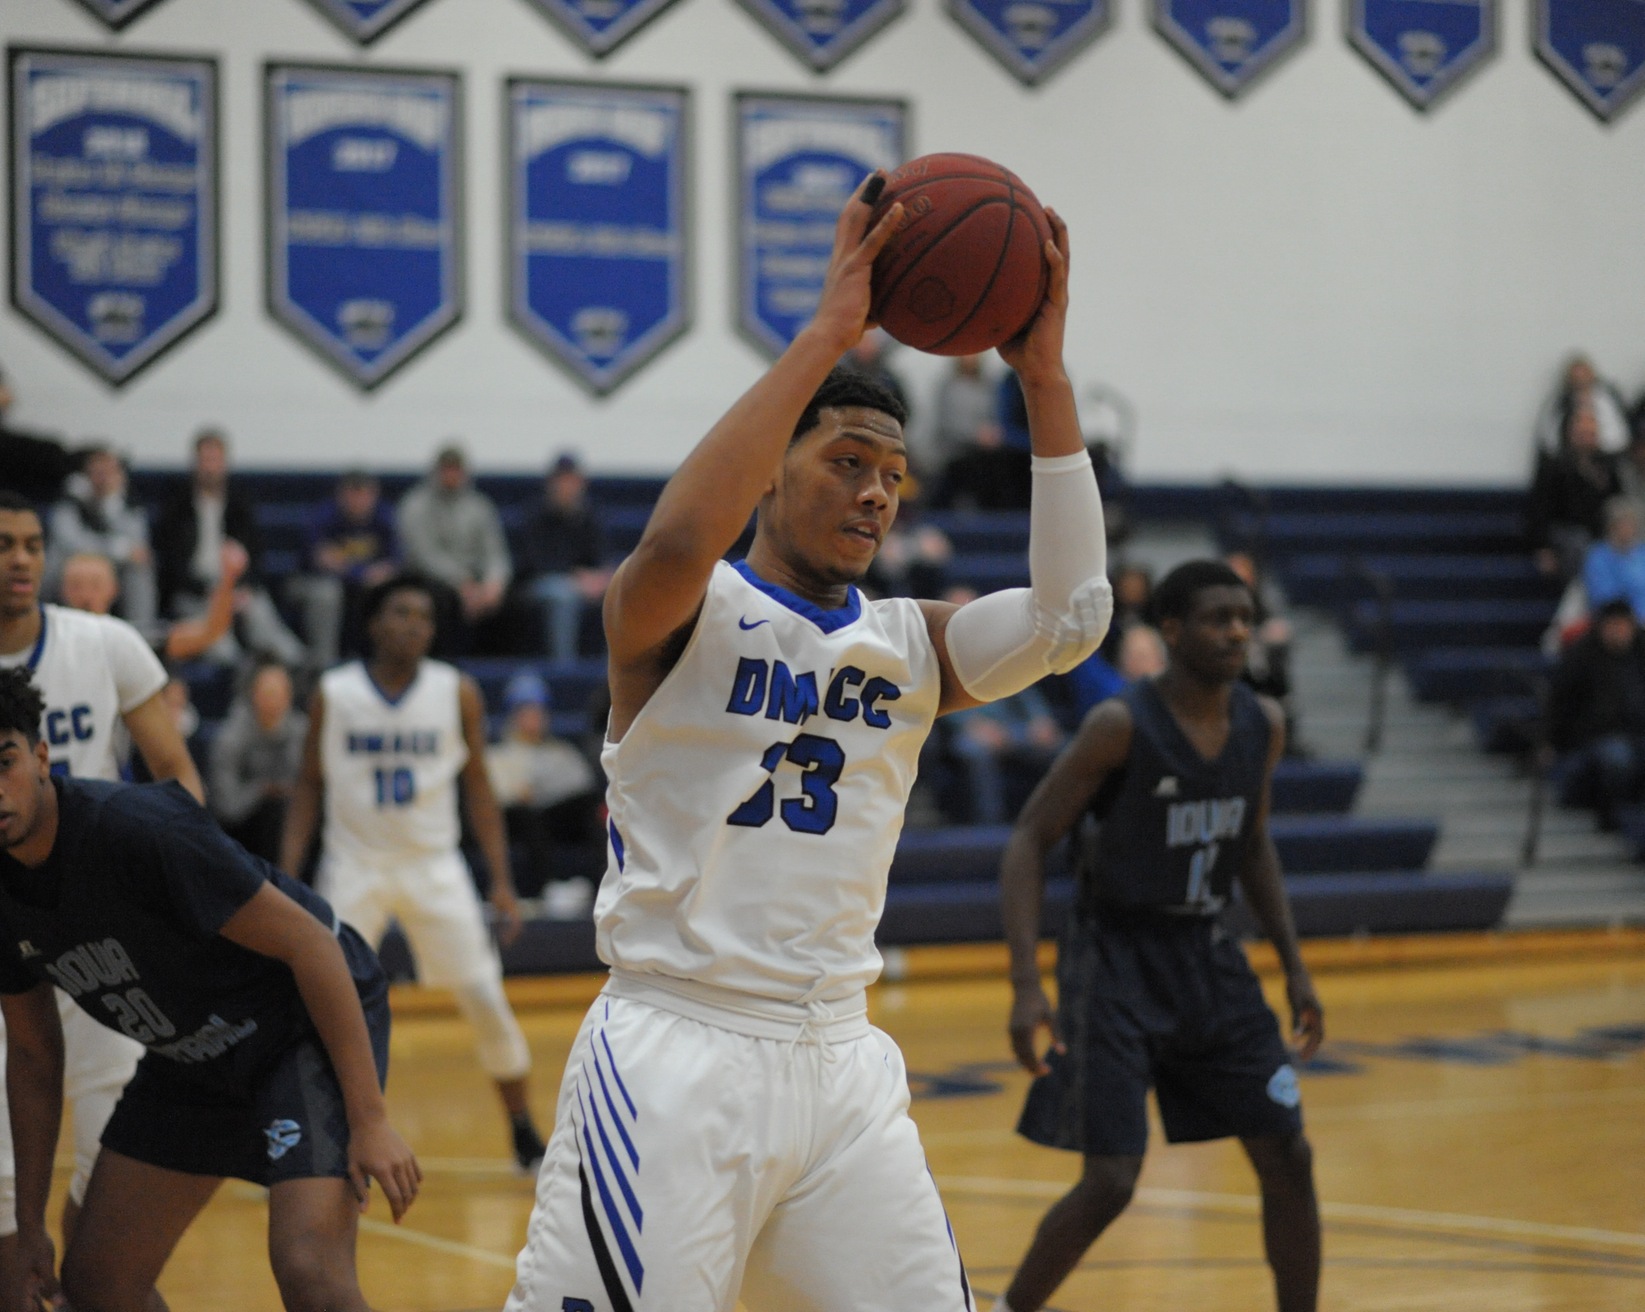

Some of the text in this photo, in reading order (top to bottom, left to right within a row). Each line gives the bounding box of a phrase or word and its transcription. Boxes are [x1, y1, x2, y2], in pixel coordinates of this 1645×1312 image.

[725, 656, 902, 730] DMCC
[46, 937, 141, 998] IOWA
[101, 986, 177, 1043] 20
